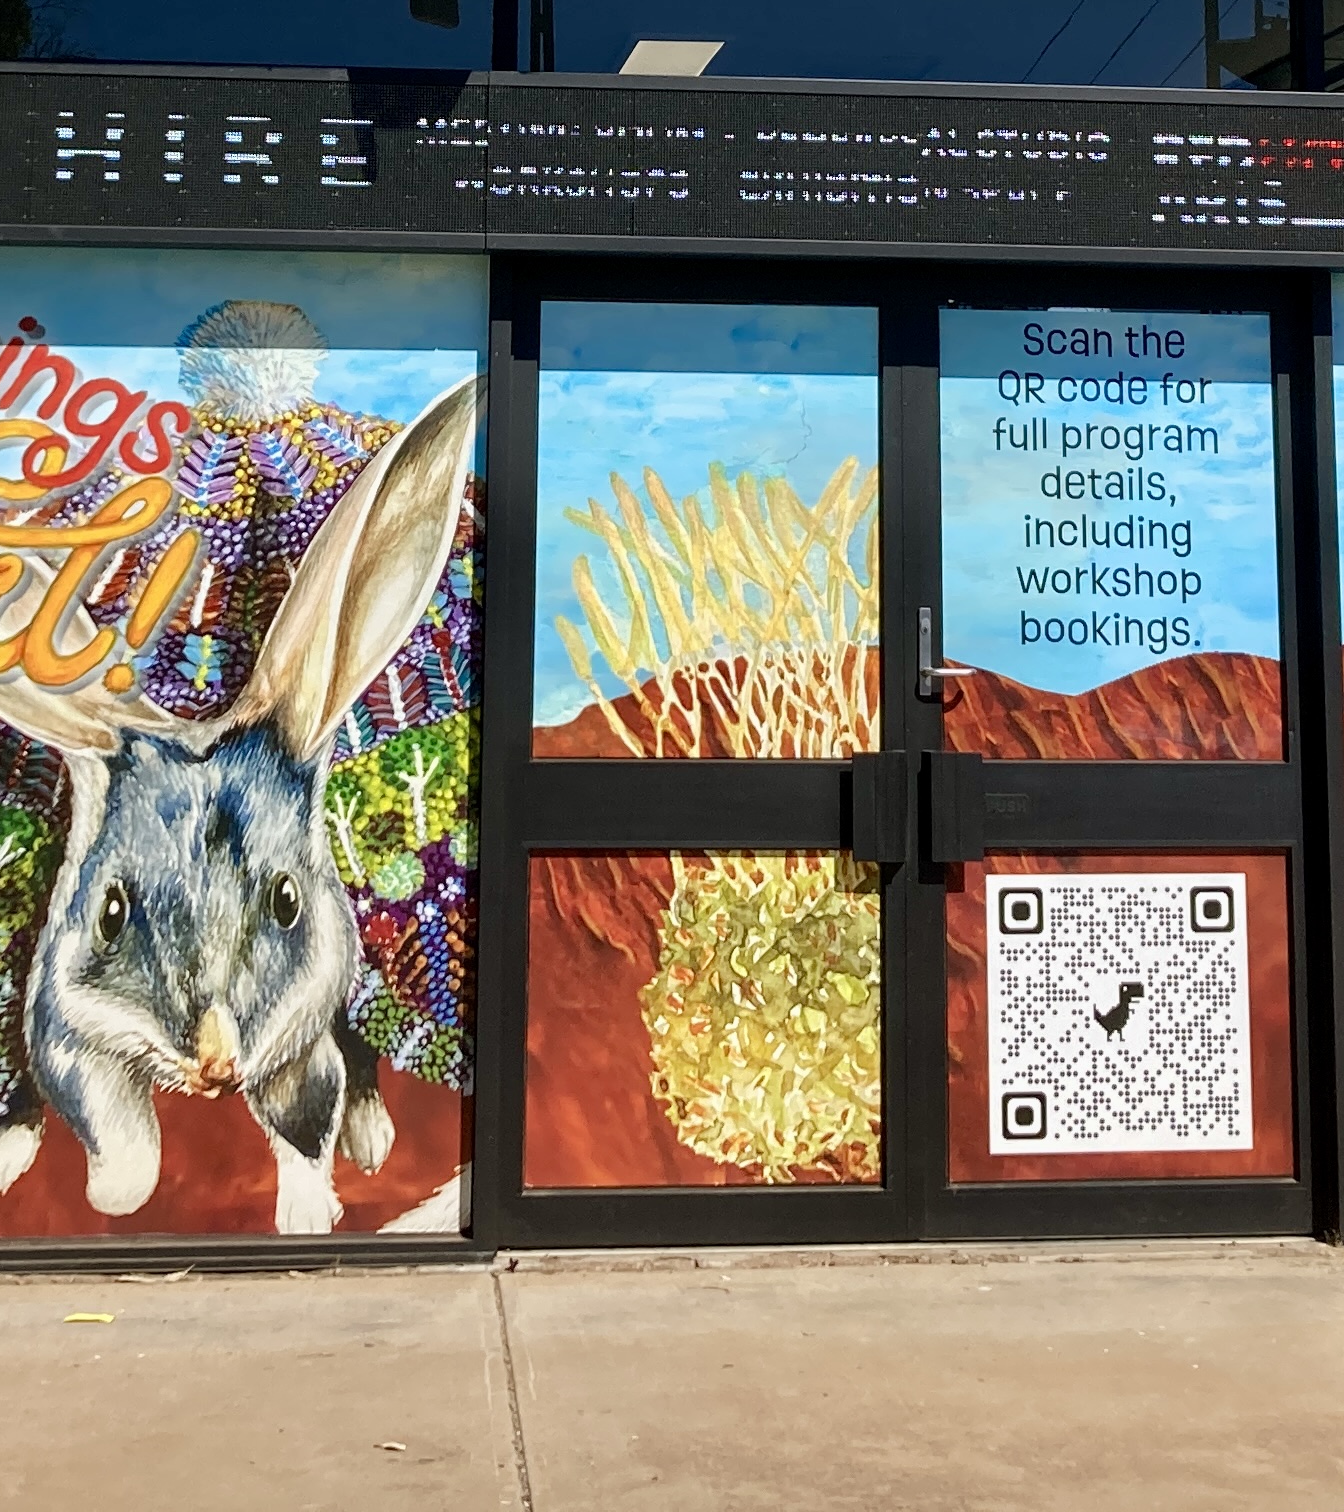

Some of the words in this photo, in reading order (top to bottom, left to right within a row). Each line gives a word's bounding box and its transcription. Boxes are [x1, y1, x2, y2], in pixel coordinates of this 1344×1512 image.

[55, 111, 375, 190] HIRE
[1022, 322, 1113, 358] Scan
[1125, 325, 1186, 359] the
[997, 369, 1047, 407] QR
[1057, 372, 1149, 406] code
[1160, 372, 1213, 406] for
[992, 416, 1049, 452] full
[1061, 421, 1219, 461] program
[1040, 466, 1177, 508] details,
[1023, 514, 1192, 558] including
[1016, 562, 1202, 604] workshop
[1020, 610, 1202, 655] bookings.
